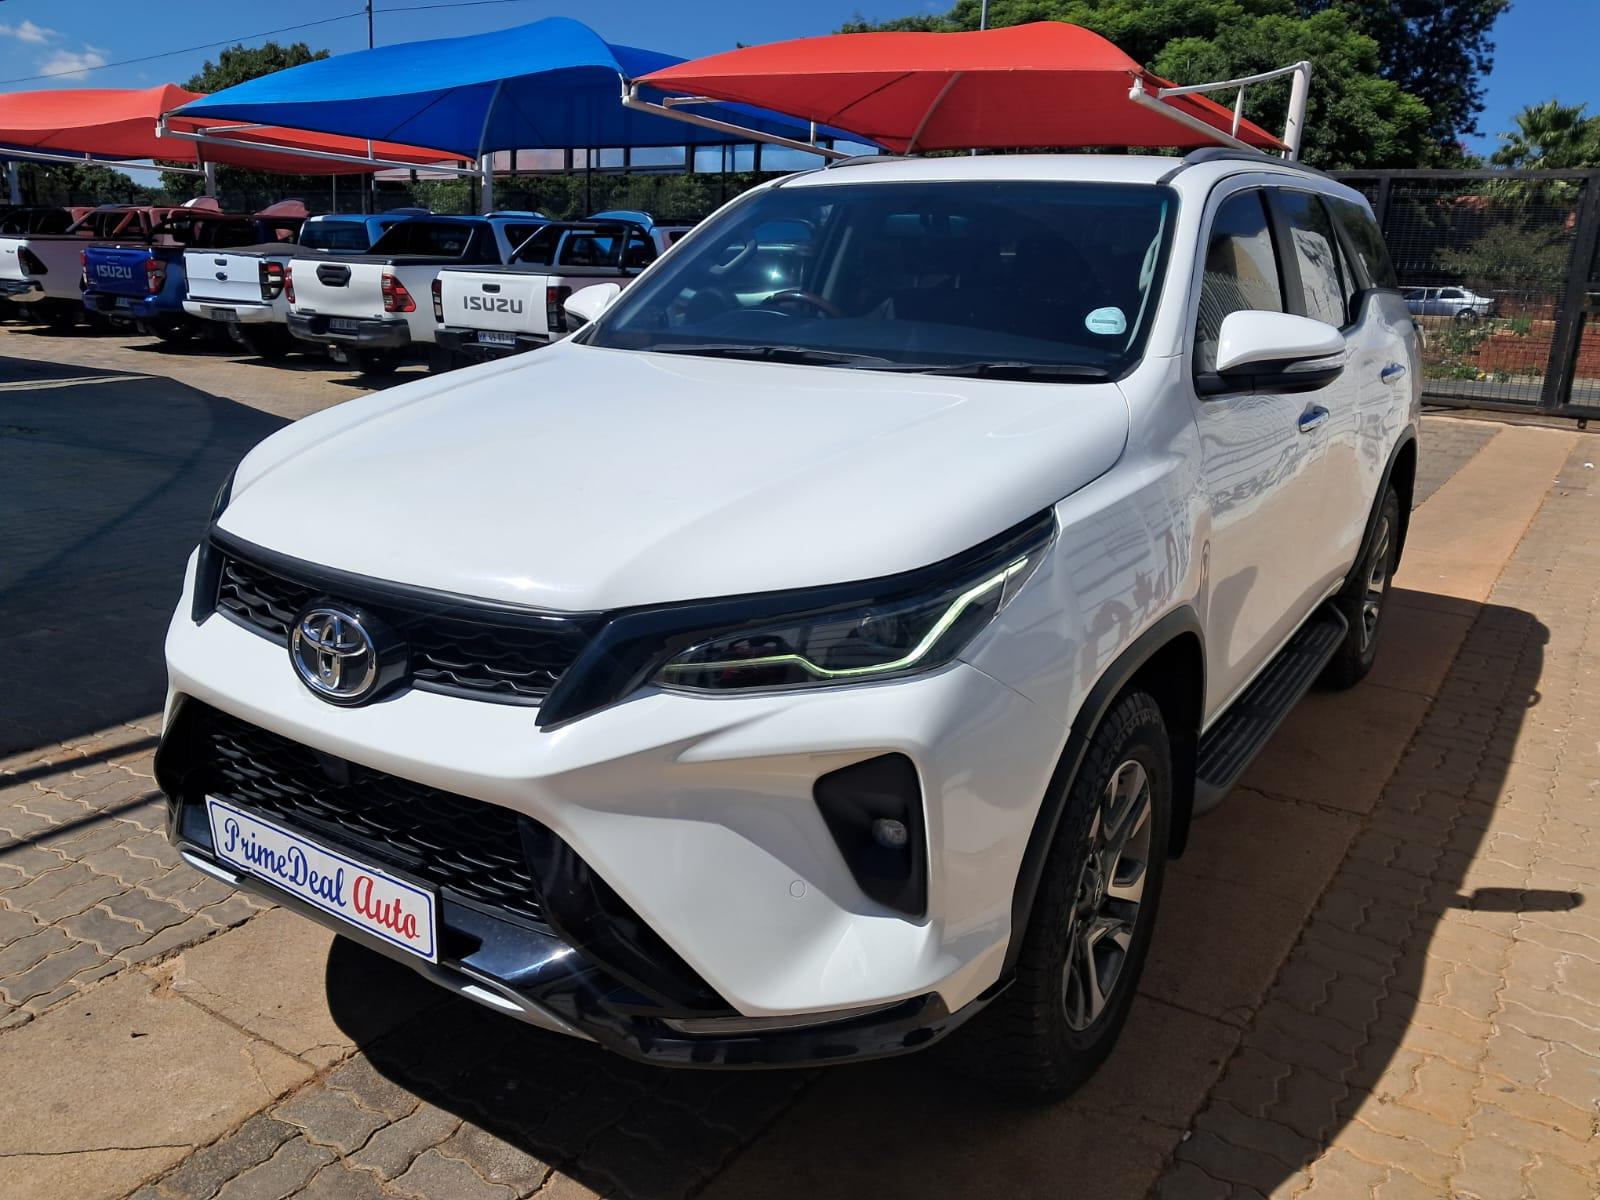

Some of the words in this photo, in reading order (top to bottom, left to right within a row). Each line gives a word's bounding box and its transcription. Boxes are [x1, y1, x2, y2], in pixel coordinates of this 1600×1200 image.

[96, 264, 132, 279] ISUZU
[464, 296, 523, 314] ISUZU
[224, 817, 347, 906] PrimeDeal
[353, 875, 420, 939] Auto
